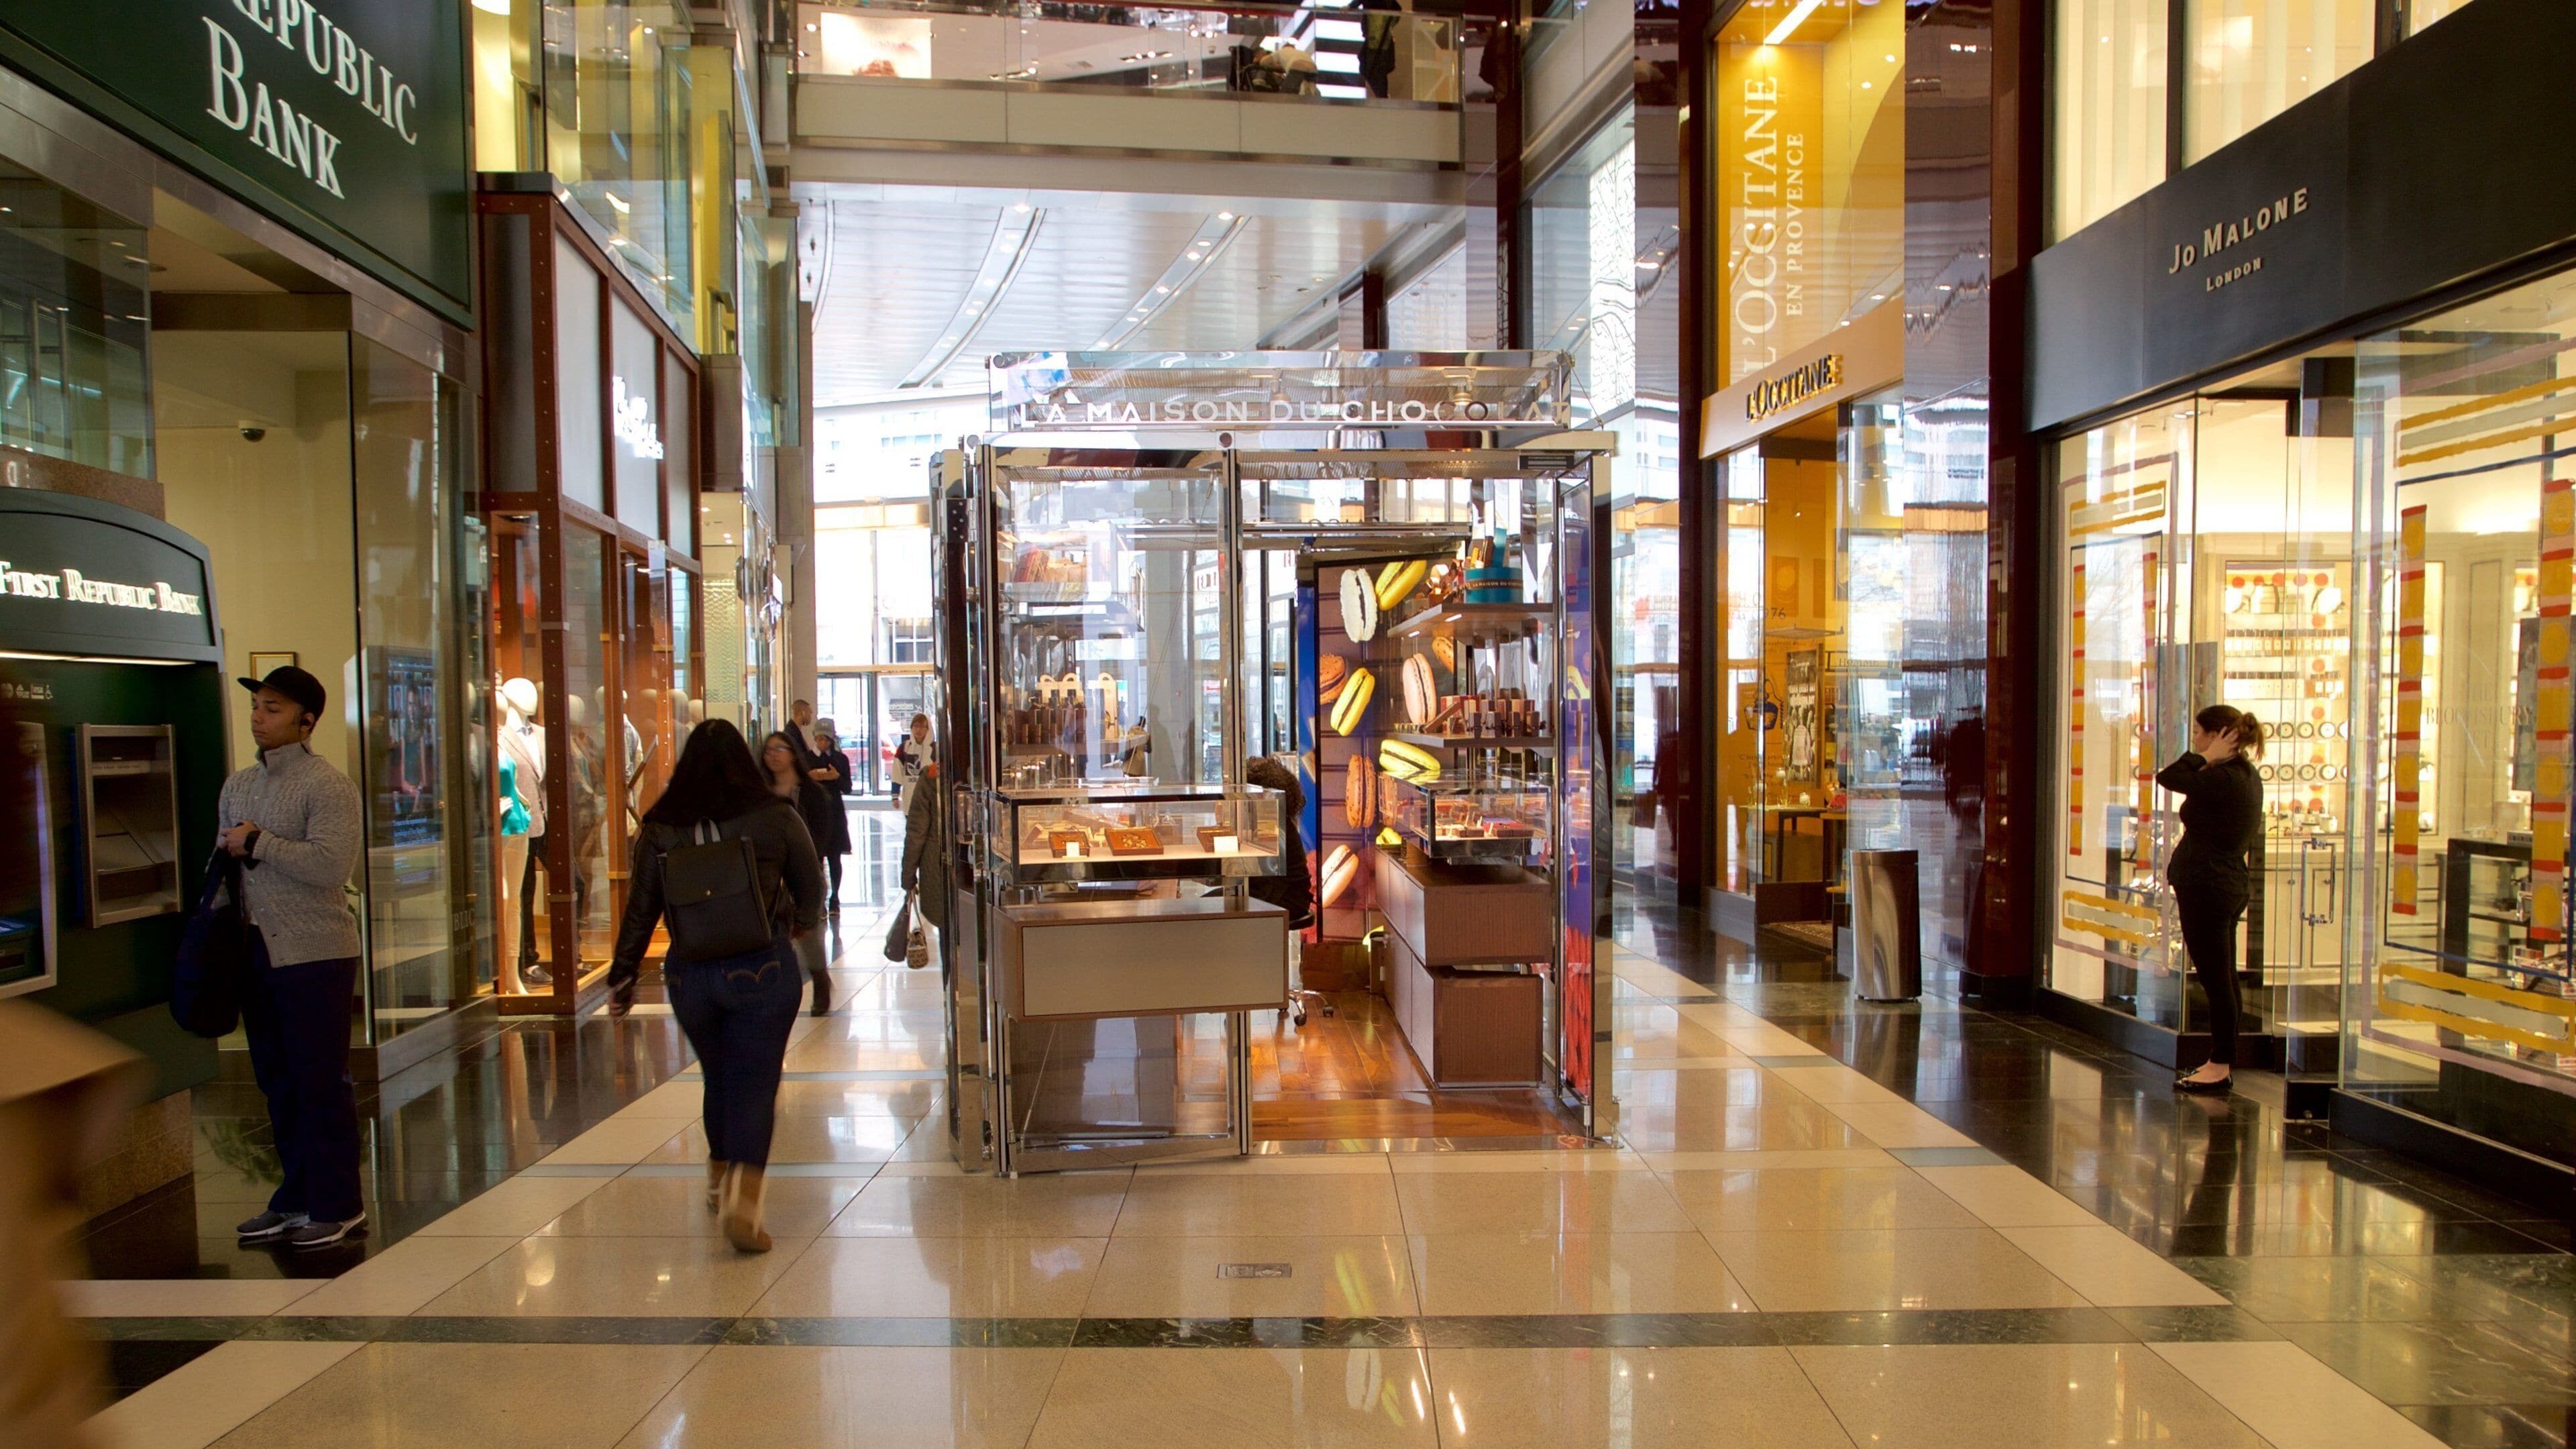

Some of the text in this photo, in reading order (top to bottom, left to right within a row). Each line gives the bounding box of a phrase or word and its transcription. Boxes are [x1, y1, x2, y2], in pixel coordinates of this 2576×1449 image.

[202, 16, 345, 200] BANK
[231, 0, 417, 146] EPUBLIC
[1735, 76, 1778, 374] L'OCCITANE
[1786, 133, 1804, 317] EN PROVENCE
[2204, 187, 2308, 258] MALONE
[2206, 258, 2262, 292] LONDON
[1020, 400, 1568, 428] LA MAISON DU CHOCOLAT
[1746, 354, 1838, 422] L'OCCITANE
[0, 561, 202, 615] FIRST REPUBLIC BANK
